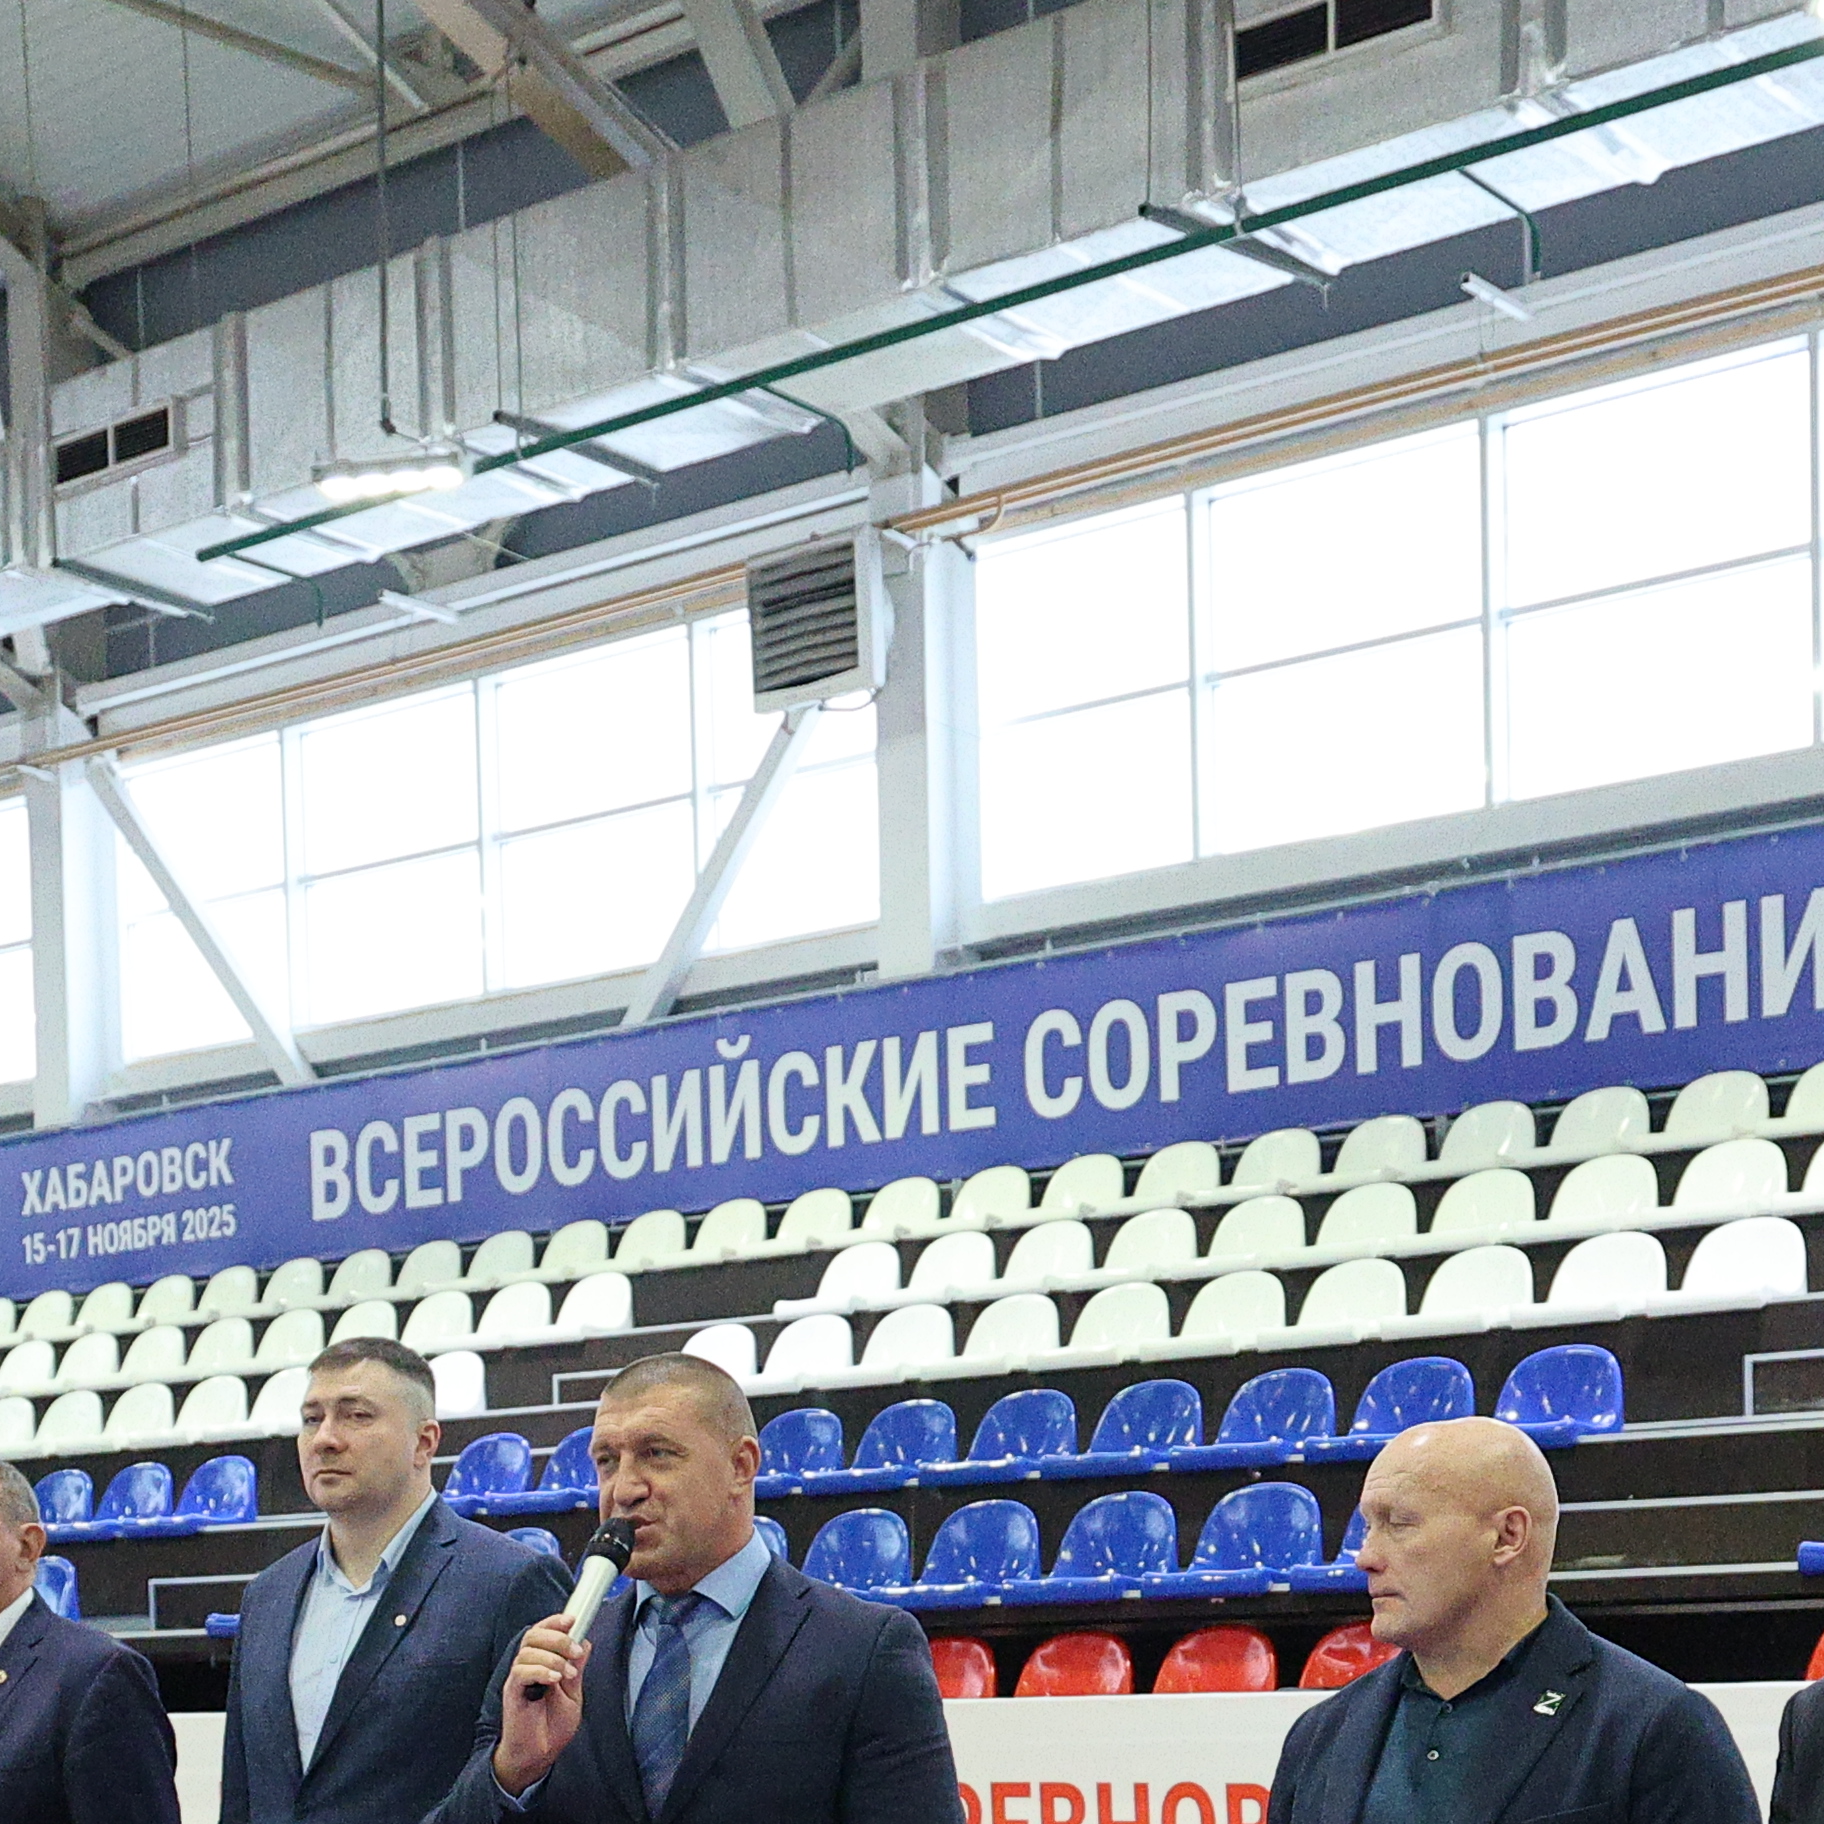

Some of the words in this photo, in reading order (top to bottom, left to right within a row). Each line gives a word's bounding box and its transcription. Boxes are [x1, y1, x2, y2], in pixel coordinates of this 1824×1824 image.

[309, 1022, 996, 1221] ВСЕРОССИЙСКИЕ
[21, 1138, 235, 1216] ХАБАРОВСК
[22, 1228, 82, 1265] 15-17
[87, 1212, 177, 1256] НОЯБРЯ
[182, 1203, 237, 1244] 2025
